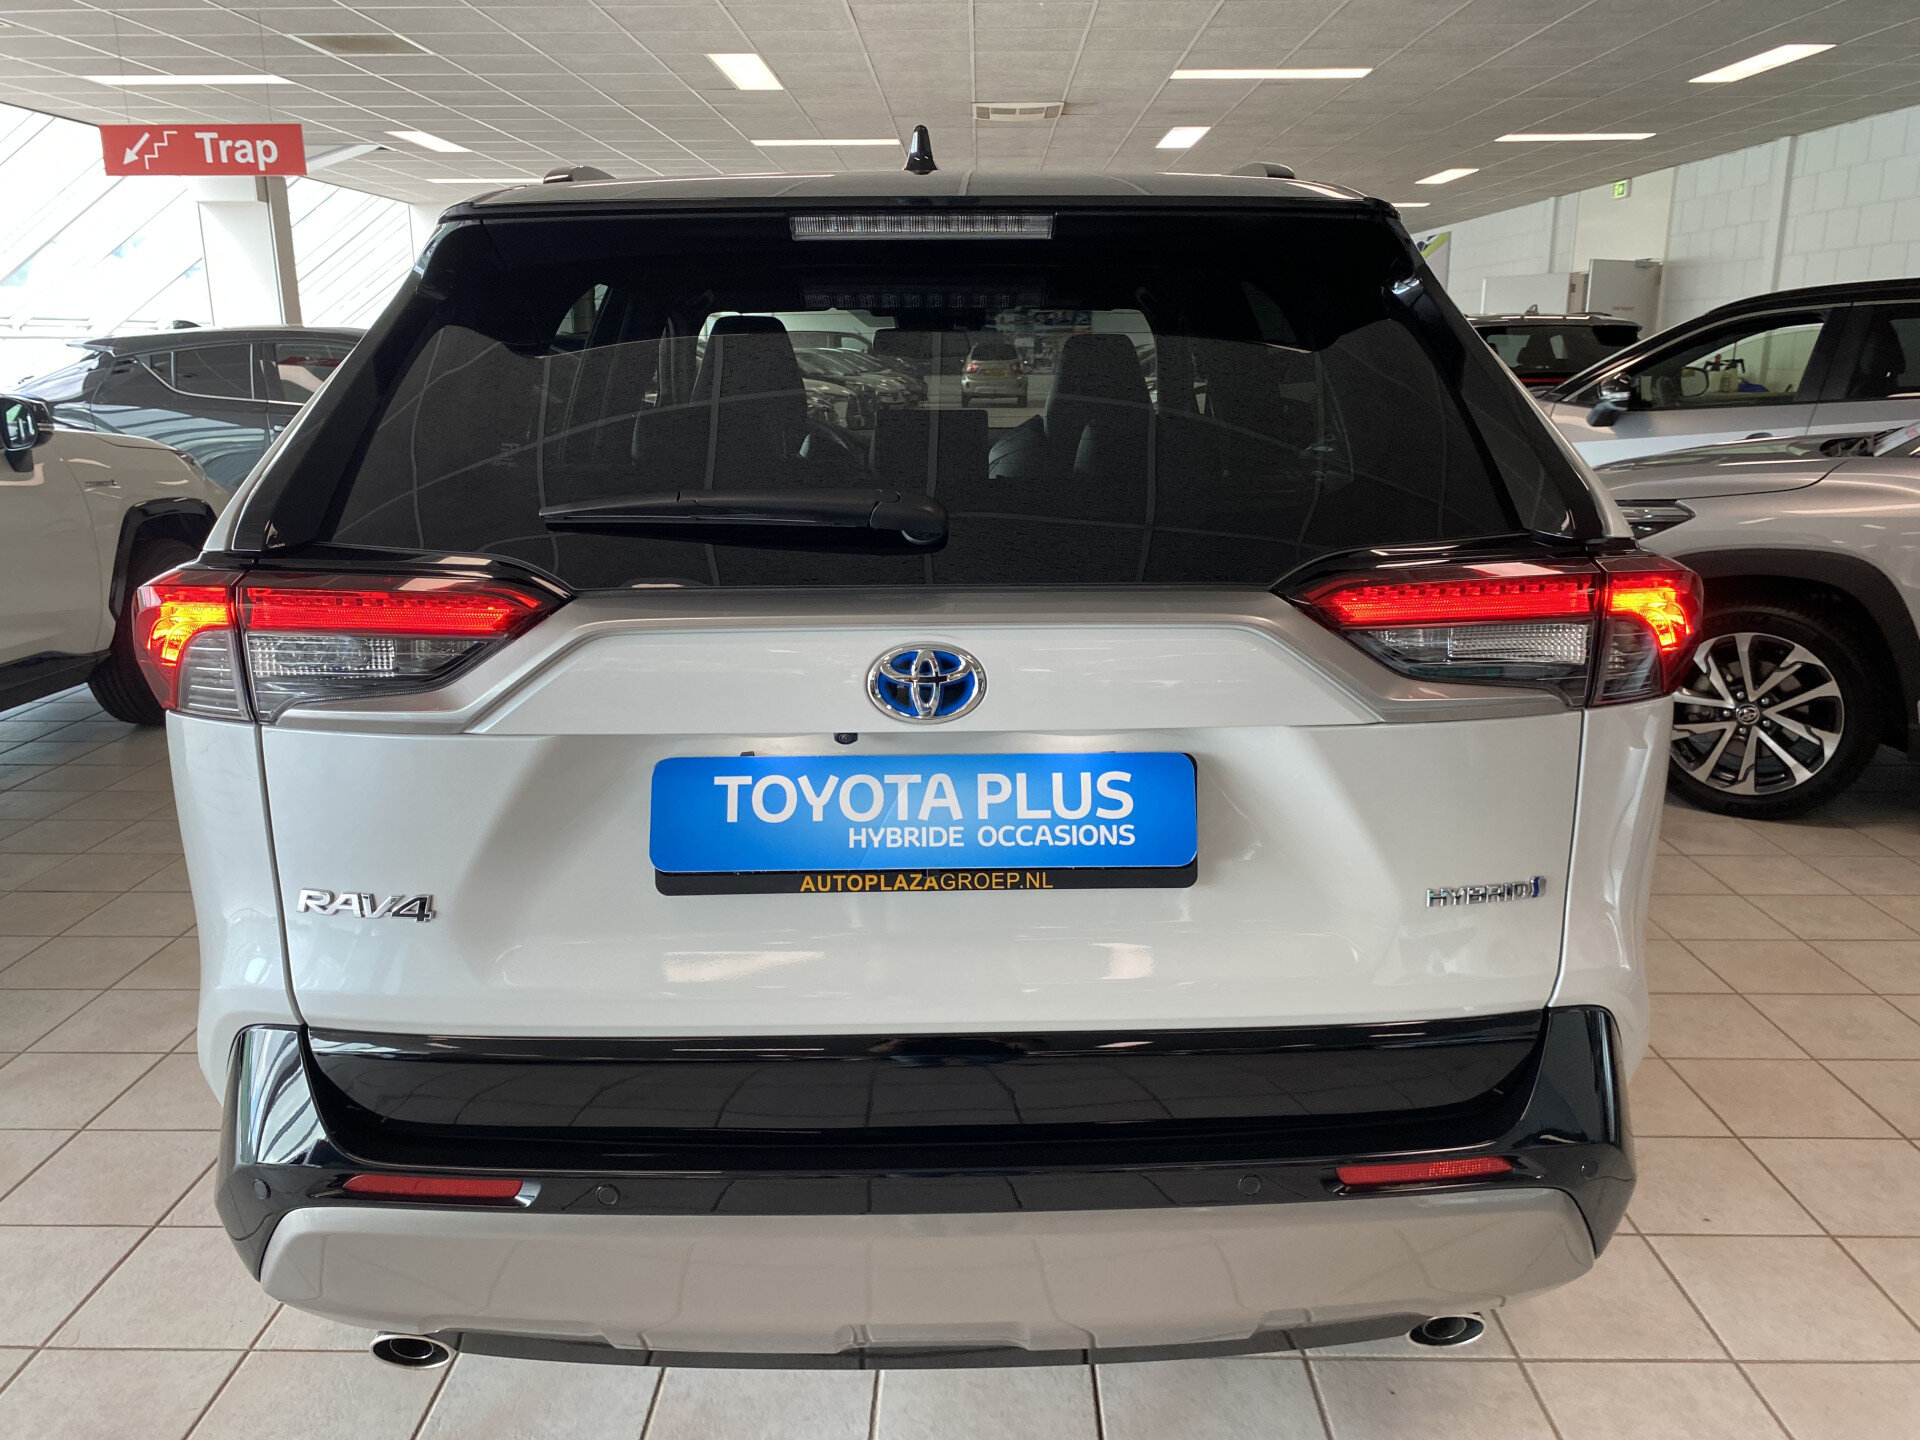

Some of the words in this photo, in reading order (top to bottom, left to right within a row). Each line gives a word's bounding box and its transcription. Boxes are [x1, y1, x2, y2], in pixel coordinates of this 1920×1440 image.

[194, 131, 279, 171] Trap
[713, 773, 963, 823] TOYOTA
[977, 771, 1134, 819] PLUS
[848, 826, 965, 848] HYBRIDE
[977, 824, 1136, 846] OCCASIONS
[799, 871, 1054, 892] AUTOPLAZAGROEP.NL
[1426, 882, 1529, 907] HYBRID
[297, 888, 436, 923] RAV4
